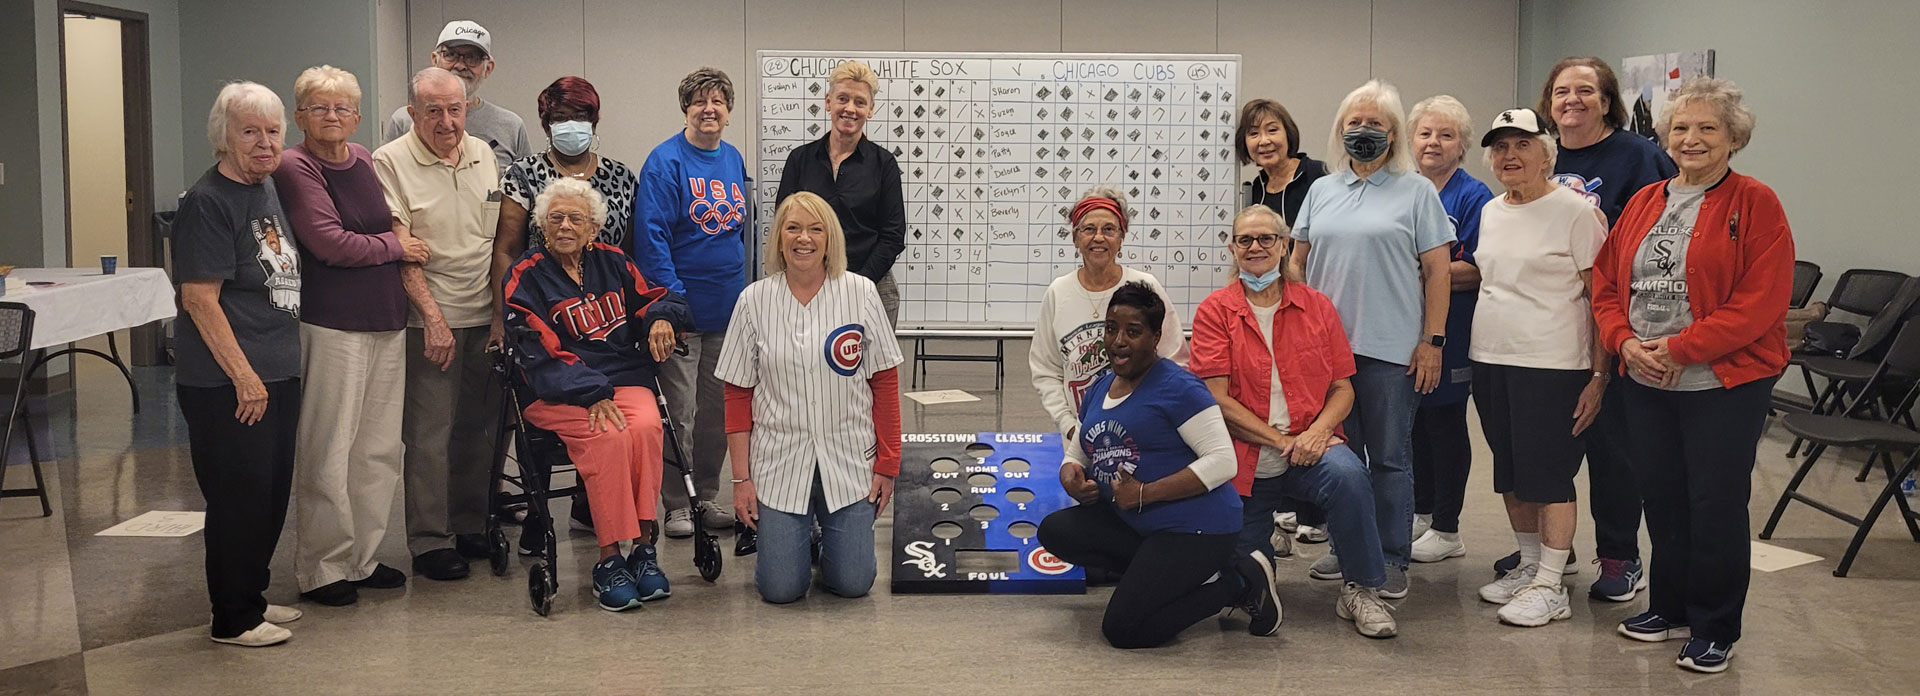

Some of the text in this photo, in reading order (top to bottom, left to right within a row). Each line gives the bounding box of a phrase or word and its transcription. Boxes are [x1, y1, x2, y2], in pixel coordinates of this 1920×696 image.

[455, 26, 486, 39] Chicago
[790, 58, 856, 76] CHICA
[930, 60, 968, 76] SOX
[1053, 61, 1176, 80] CHICAGO CUBS
[1213, 64, 1228, 79] W
[771, 102, 800, 115] Eileen
[764, 167, 768, 175] 5
[688, 178, 745, 203] USA
[993, 184, 1026, 198] Evelyn T
[991, 206, 1019, 218] Beverly
[993, 230, 1016, 240] Song
[913, 247, 982, 261] 6 5 3 4
[1033, 248, 1227, 262] 5 8 6 6 0 6 6
[971, 266, 981, 275] 28
[901, 433, 1043, 443] CROSSTOWN CLASSIC
[1085, 420, 1106, 443] CUBS
[1092, 448, 1132, 464] CHAMPIONS
[980, 521, 989, 529] 3
[968, 572, 1009, 581] FOUL
